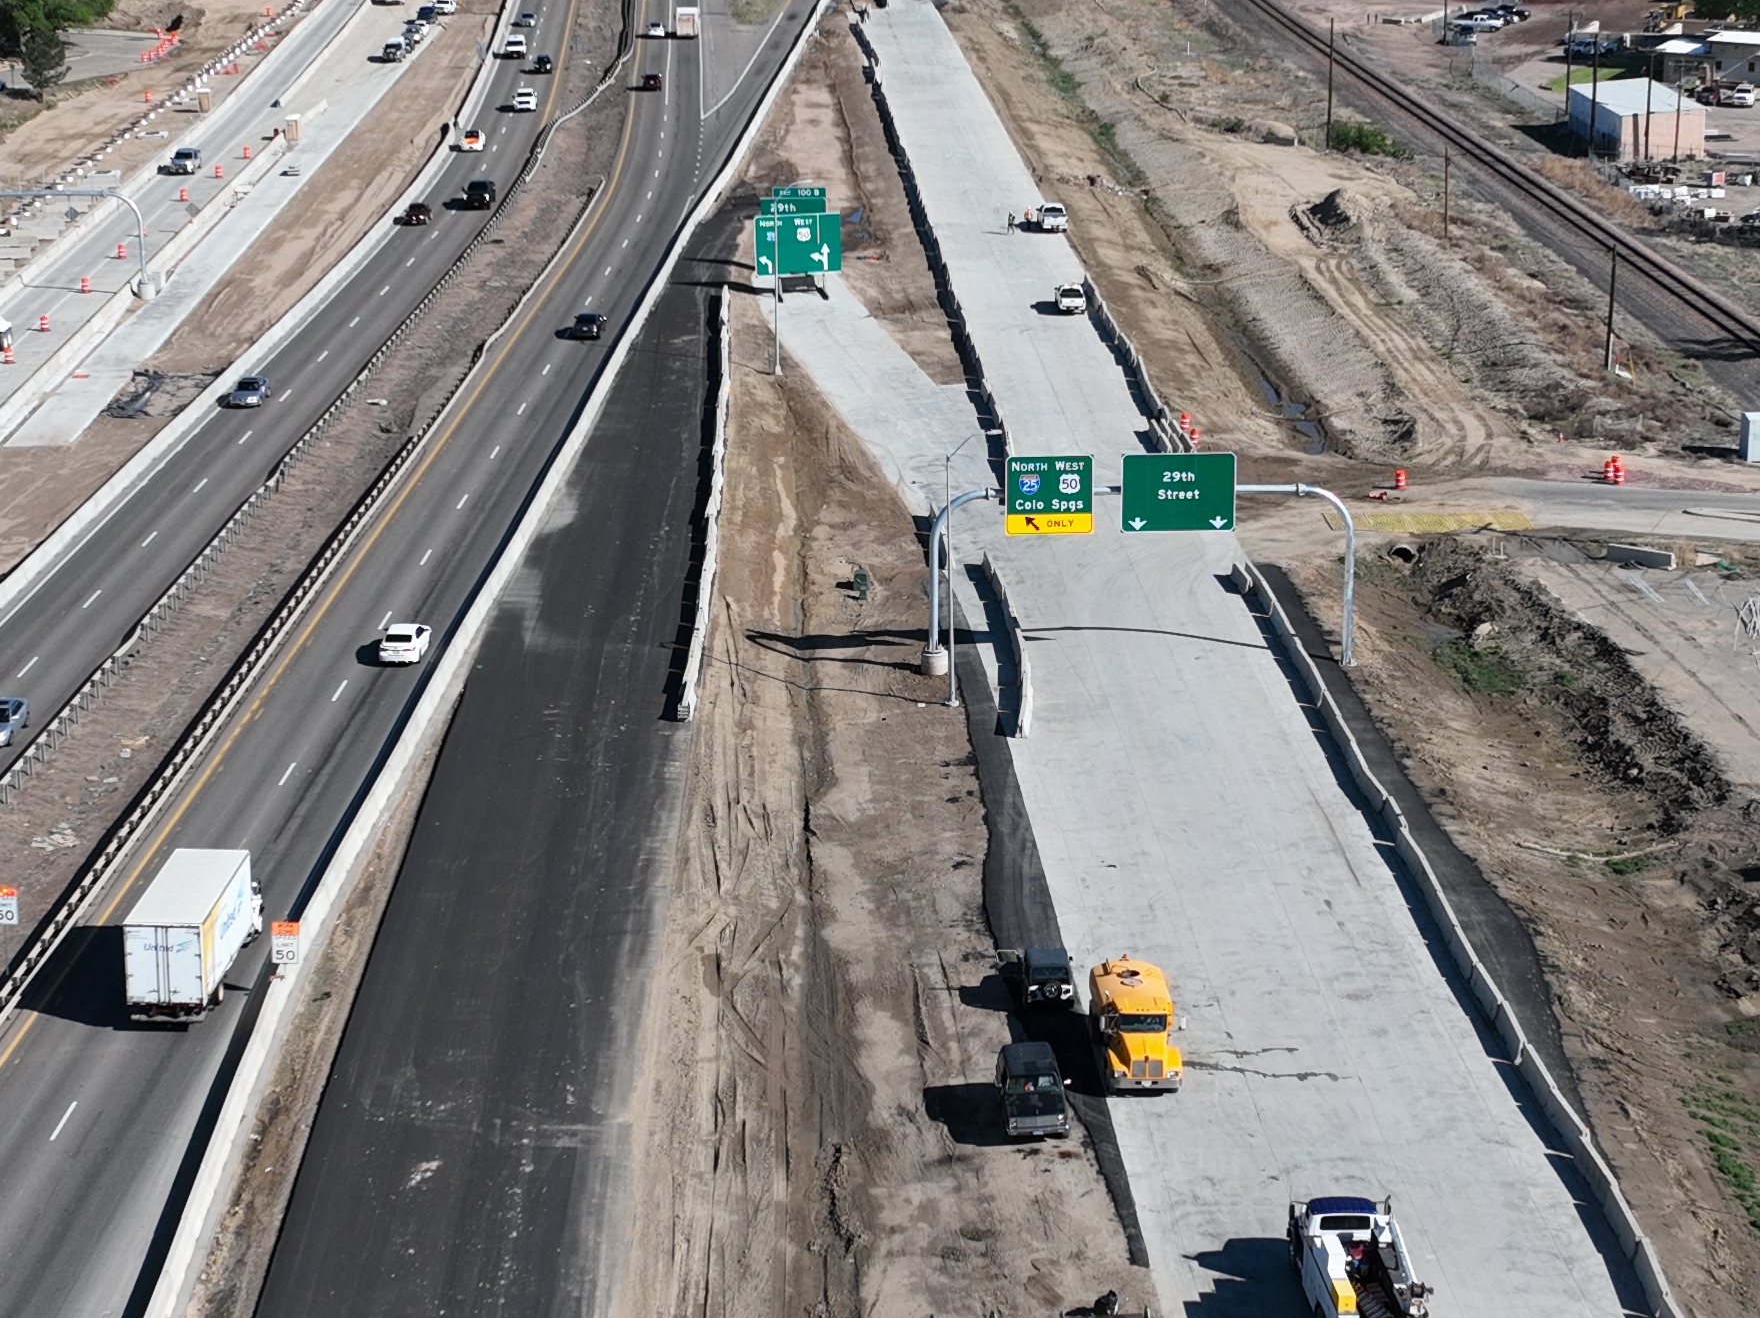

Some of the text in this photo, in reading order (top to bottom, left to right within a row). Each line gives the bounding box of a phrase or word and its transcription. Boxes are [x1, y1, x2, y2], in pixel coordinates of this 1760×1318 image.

[798, 230, 810, 239] 50
[1011, 461, 1085, 472] NORTH WEST
[1162, 471, 1196, 483] 29th
[1022, 478, 1078, 491] 25 50
[1157, 489, 1200, 500] Street
[1015, 498, 1084, 512] Colo Spgs
[1046, 519, 1074, 528] ONLY
[275, 949, 296, 961] 50
